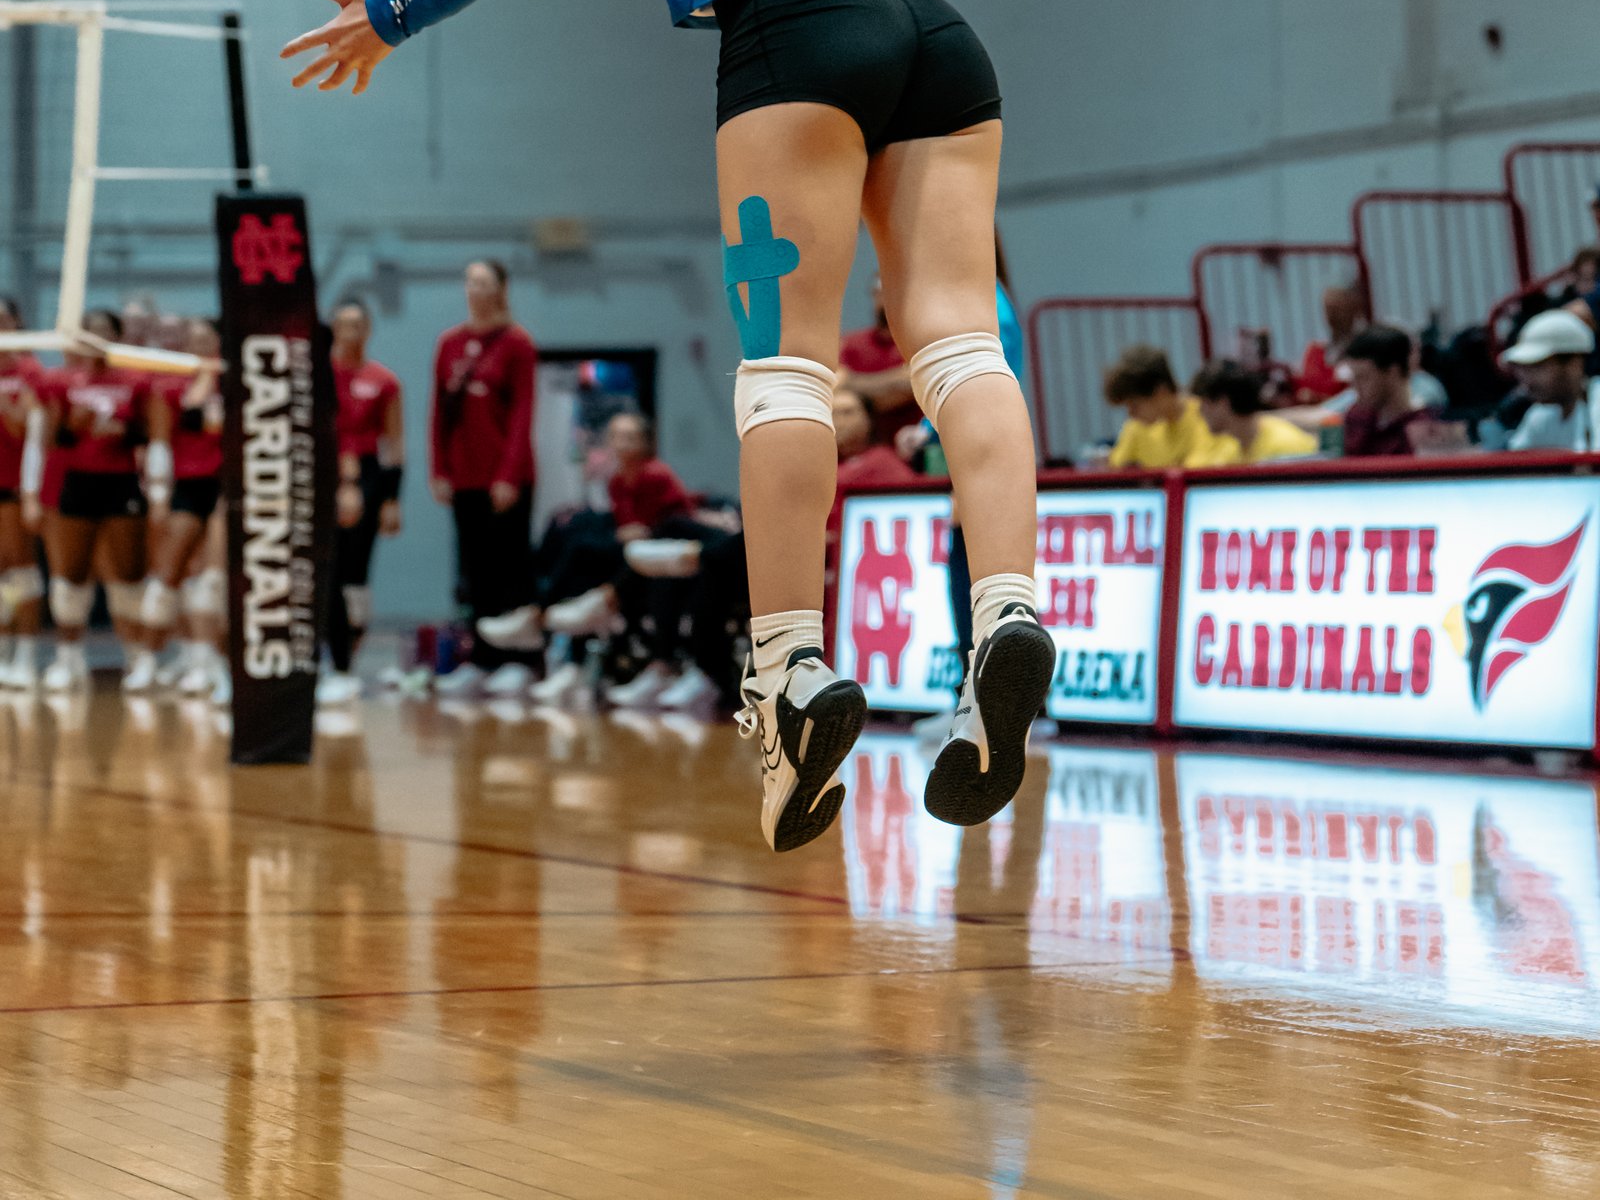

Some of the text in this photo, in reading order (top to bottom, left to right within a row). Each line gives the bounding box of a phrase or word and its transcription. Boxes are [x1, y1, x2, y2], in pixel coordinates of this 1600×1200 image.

[242, 334, 292, 679] CARDINALS
[1199, 527, 1438, 593] HOME OF THE
[1195, 614, 1435, 695] CARDINALS
